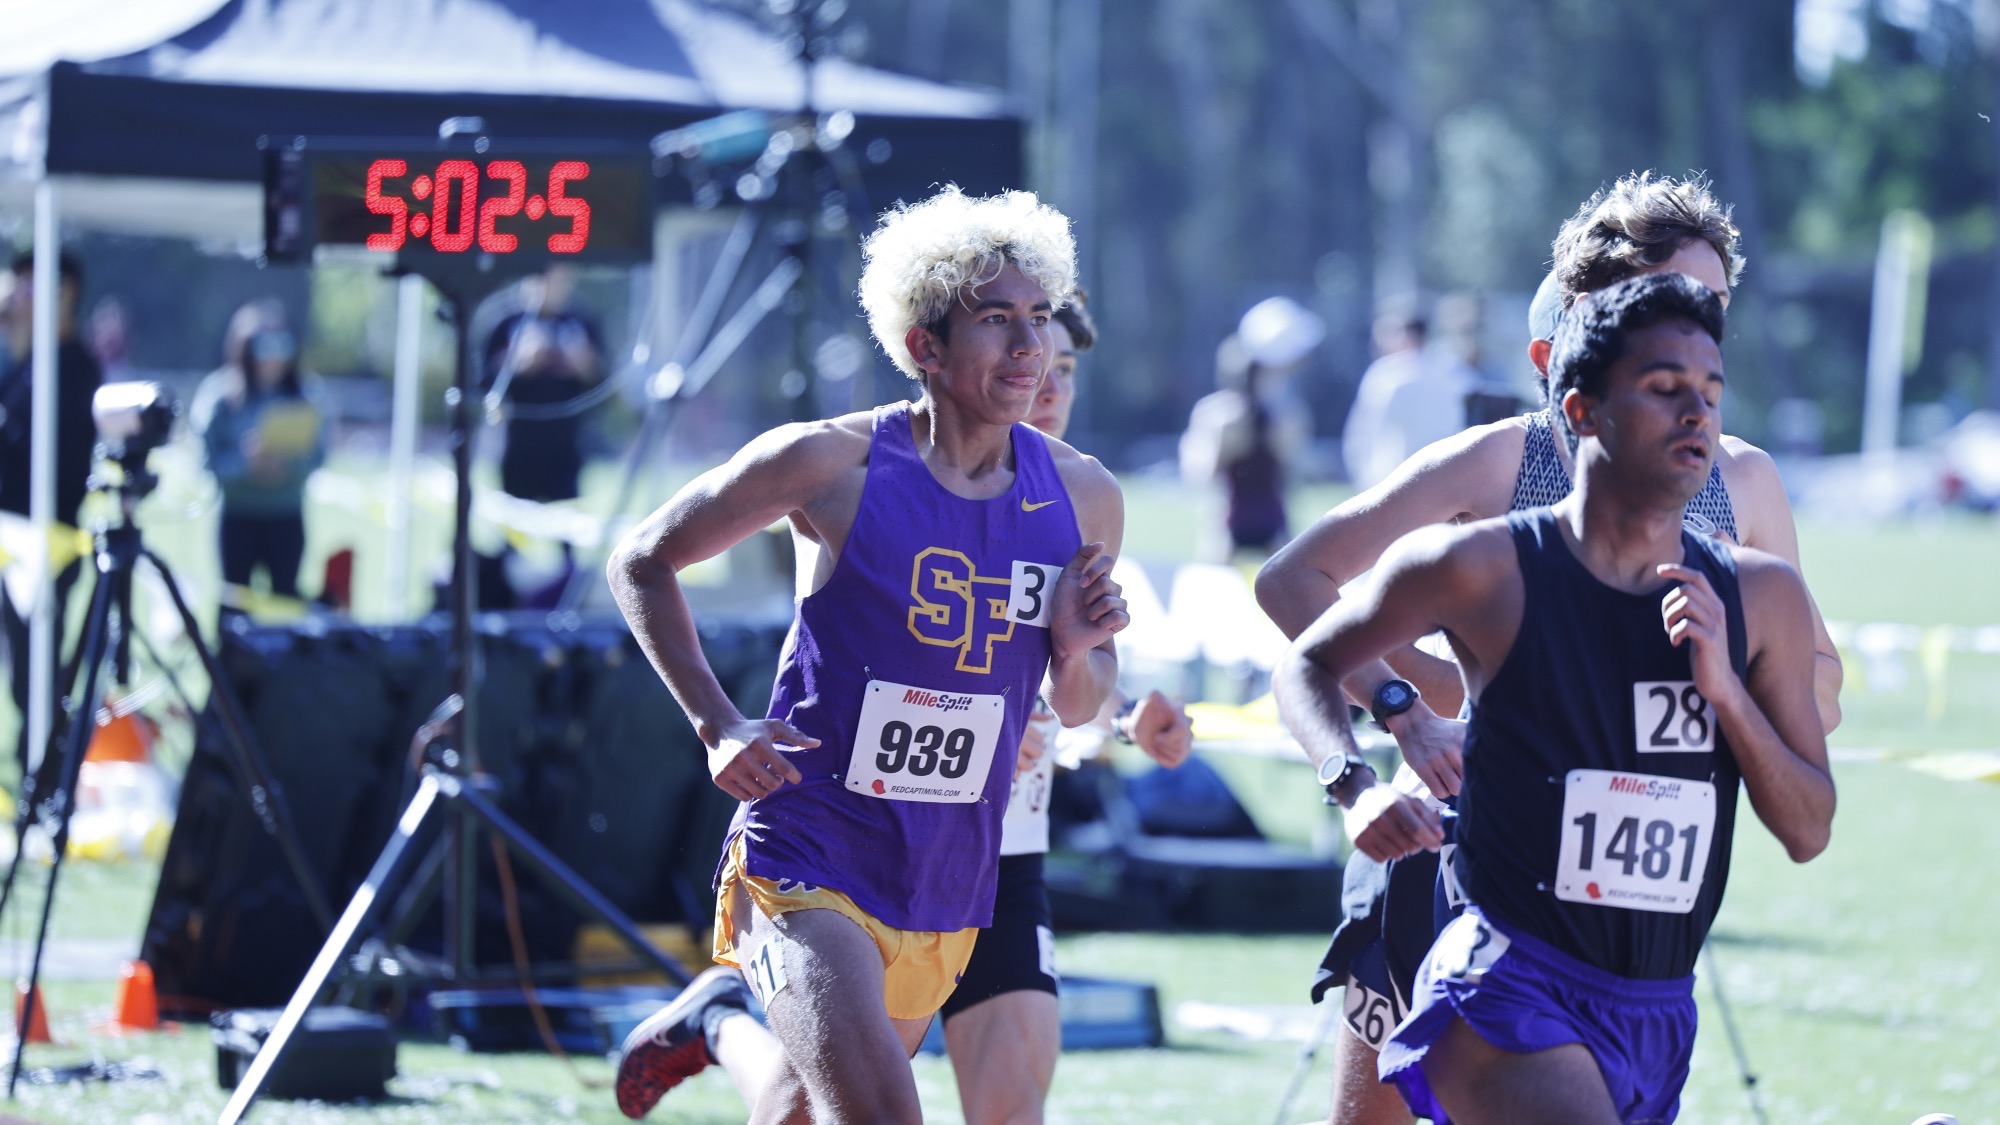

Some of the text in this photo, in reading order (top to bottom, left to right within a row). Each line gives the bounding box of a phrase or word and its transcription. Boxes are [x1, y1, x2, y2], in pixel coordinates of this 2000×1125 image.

[902, 689, 973, 712] MileSplit
[1648, 685, 1708, 747] 28
[875, 720, 975, 779] 939
[890, 785, 961, 797] REDCAPTIMING.COM
[1609, 776, 1681, 800] MileSplit
[1573, 812, 1698, 882] 1481
[1347, 982, 1389, 1046] 26
